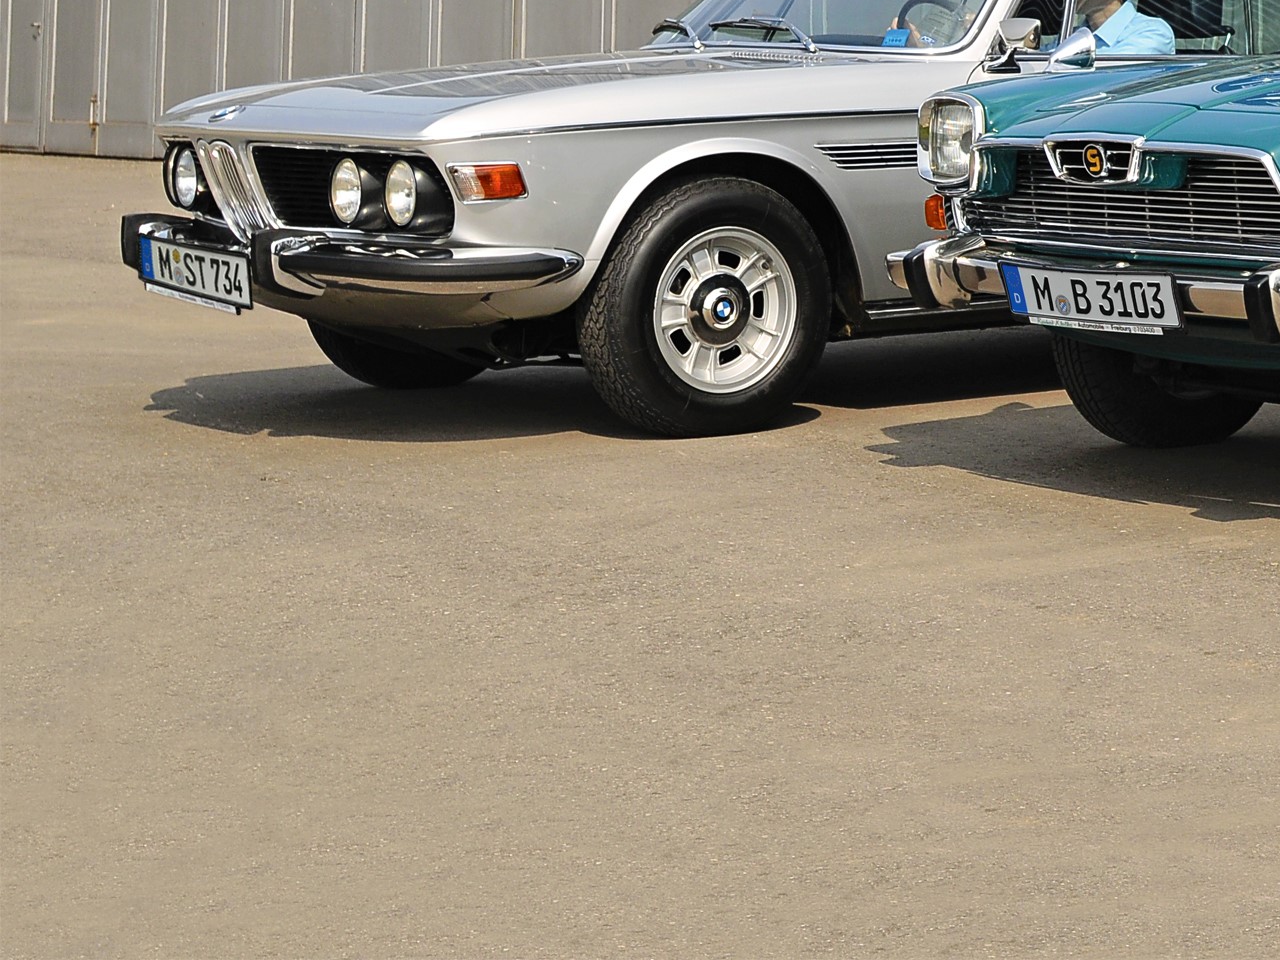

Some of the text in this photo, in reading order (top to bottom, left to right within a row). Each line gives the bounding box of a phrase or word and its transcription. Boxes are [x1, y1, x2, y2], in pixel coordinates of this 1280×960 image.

[157, 245, 243, 298] M ST 734
[1031, 275, 1165, 319] M B 3103
